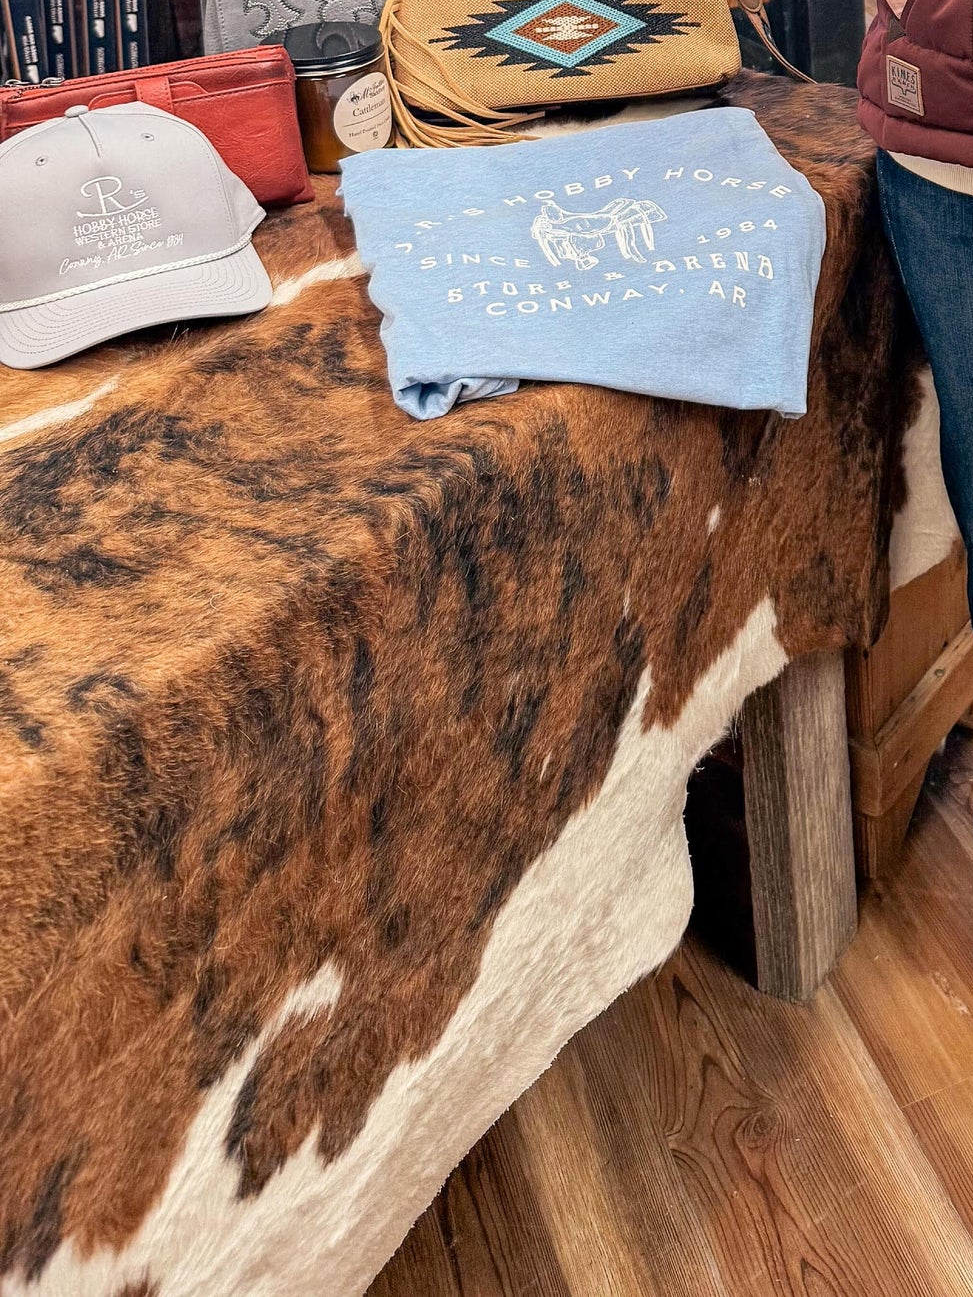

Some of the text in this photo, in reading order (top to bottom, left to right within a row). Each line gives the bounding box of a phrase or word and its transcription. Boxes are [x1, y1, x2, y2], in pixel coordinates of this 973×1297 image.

[891, 66, 916, 85] KIMES
[503, 167, 640, 206] HOBBY
[664, 167, 792, 198] HORSE
[73, 207, 160, 237] HOBBY HORSE
[75, 218, 162, 246] WESTERN STORE
[98, 233, 144, 250] & ARENA
[420, 219, 778, 270] SINCE 1984
[447, 251, 774, 303] STORE & ARENA
[708, 280, 747, 308] AR
